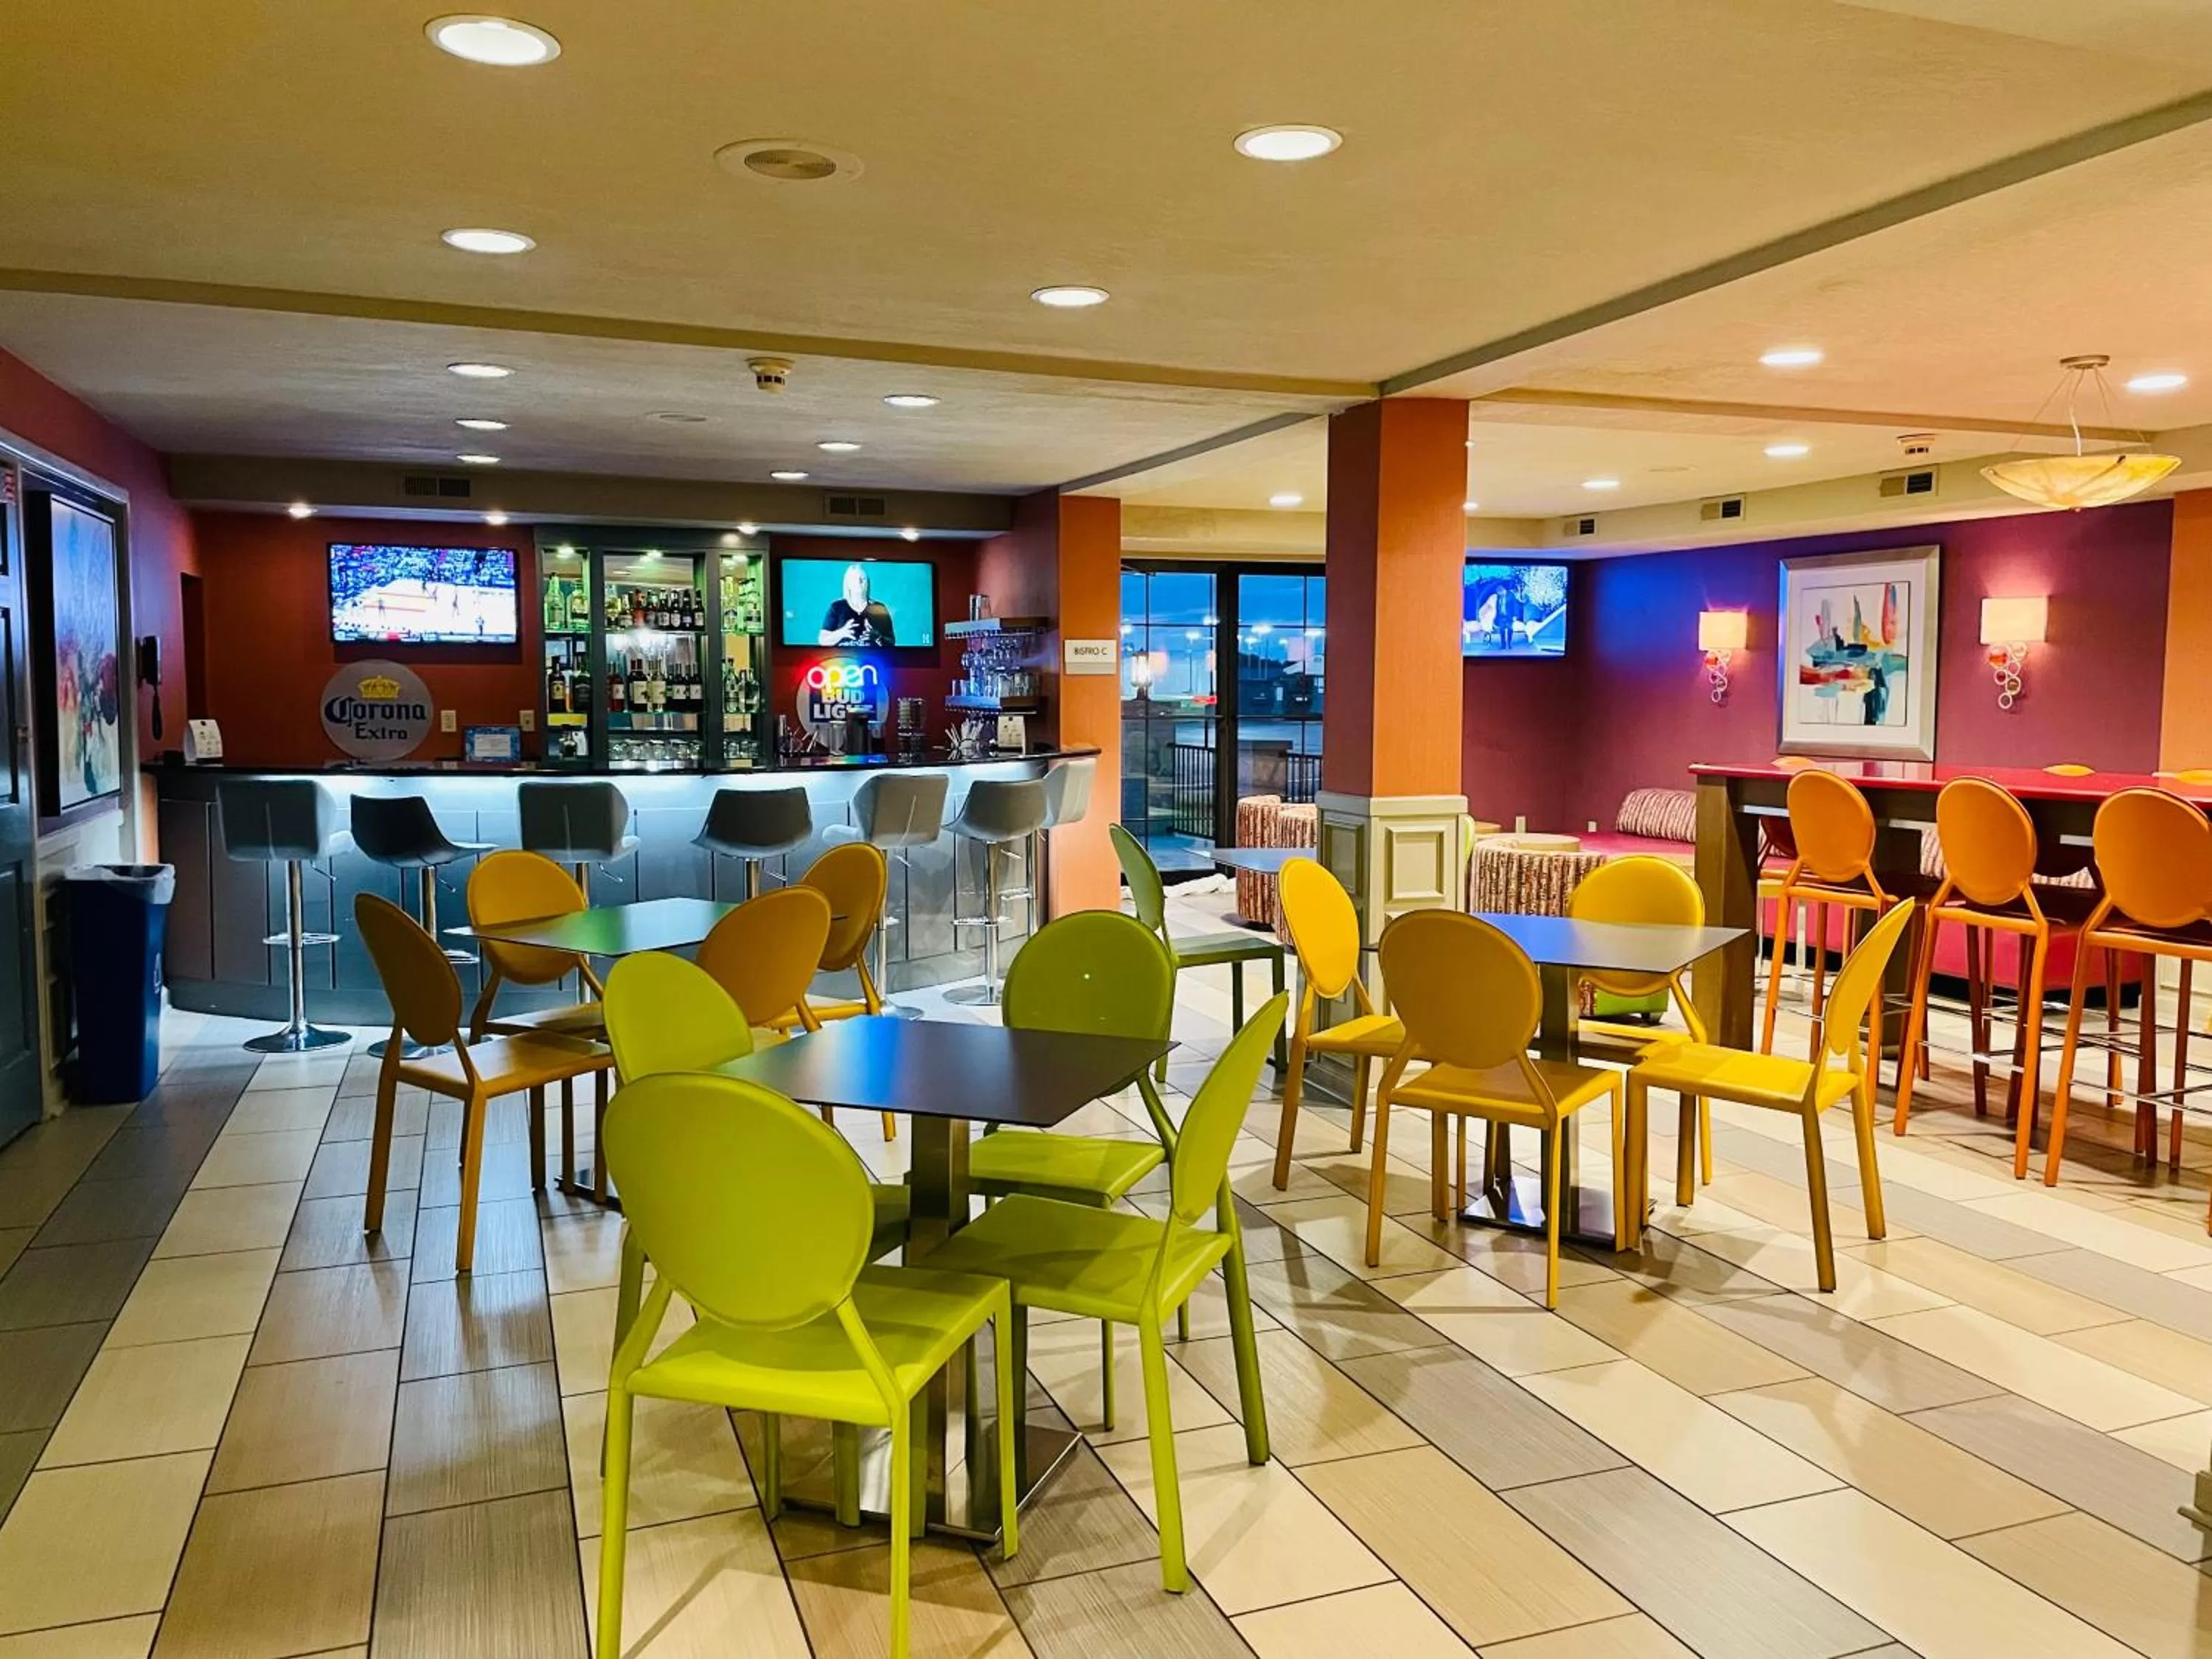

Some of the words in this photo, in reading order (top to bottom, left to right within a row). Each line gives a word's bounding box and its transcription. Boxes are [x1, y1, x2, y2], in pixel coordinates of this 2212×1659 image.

[1074, 647, 1099, 655] BISTRO
[1101, 647, 1107, 655] C
[807, 664, 878, 693] open
[821, 688, 865, 704] BUD
[324, 696, 426, 727] Corona
[813, 704, 874, 719] LIG
[354, 722, 408, 740] Extra
